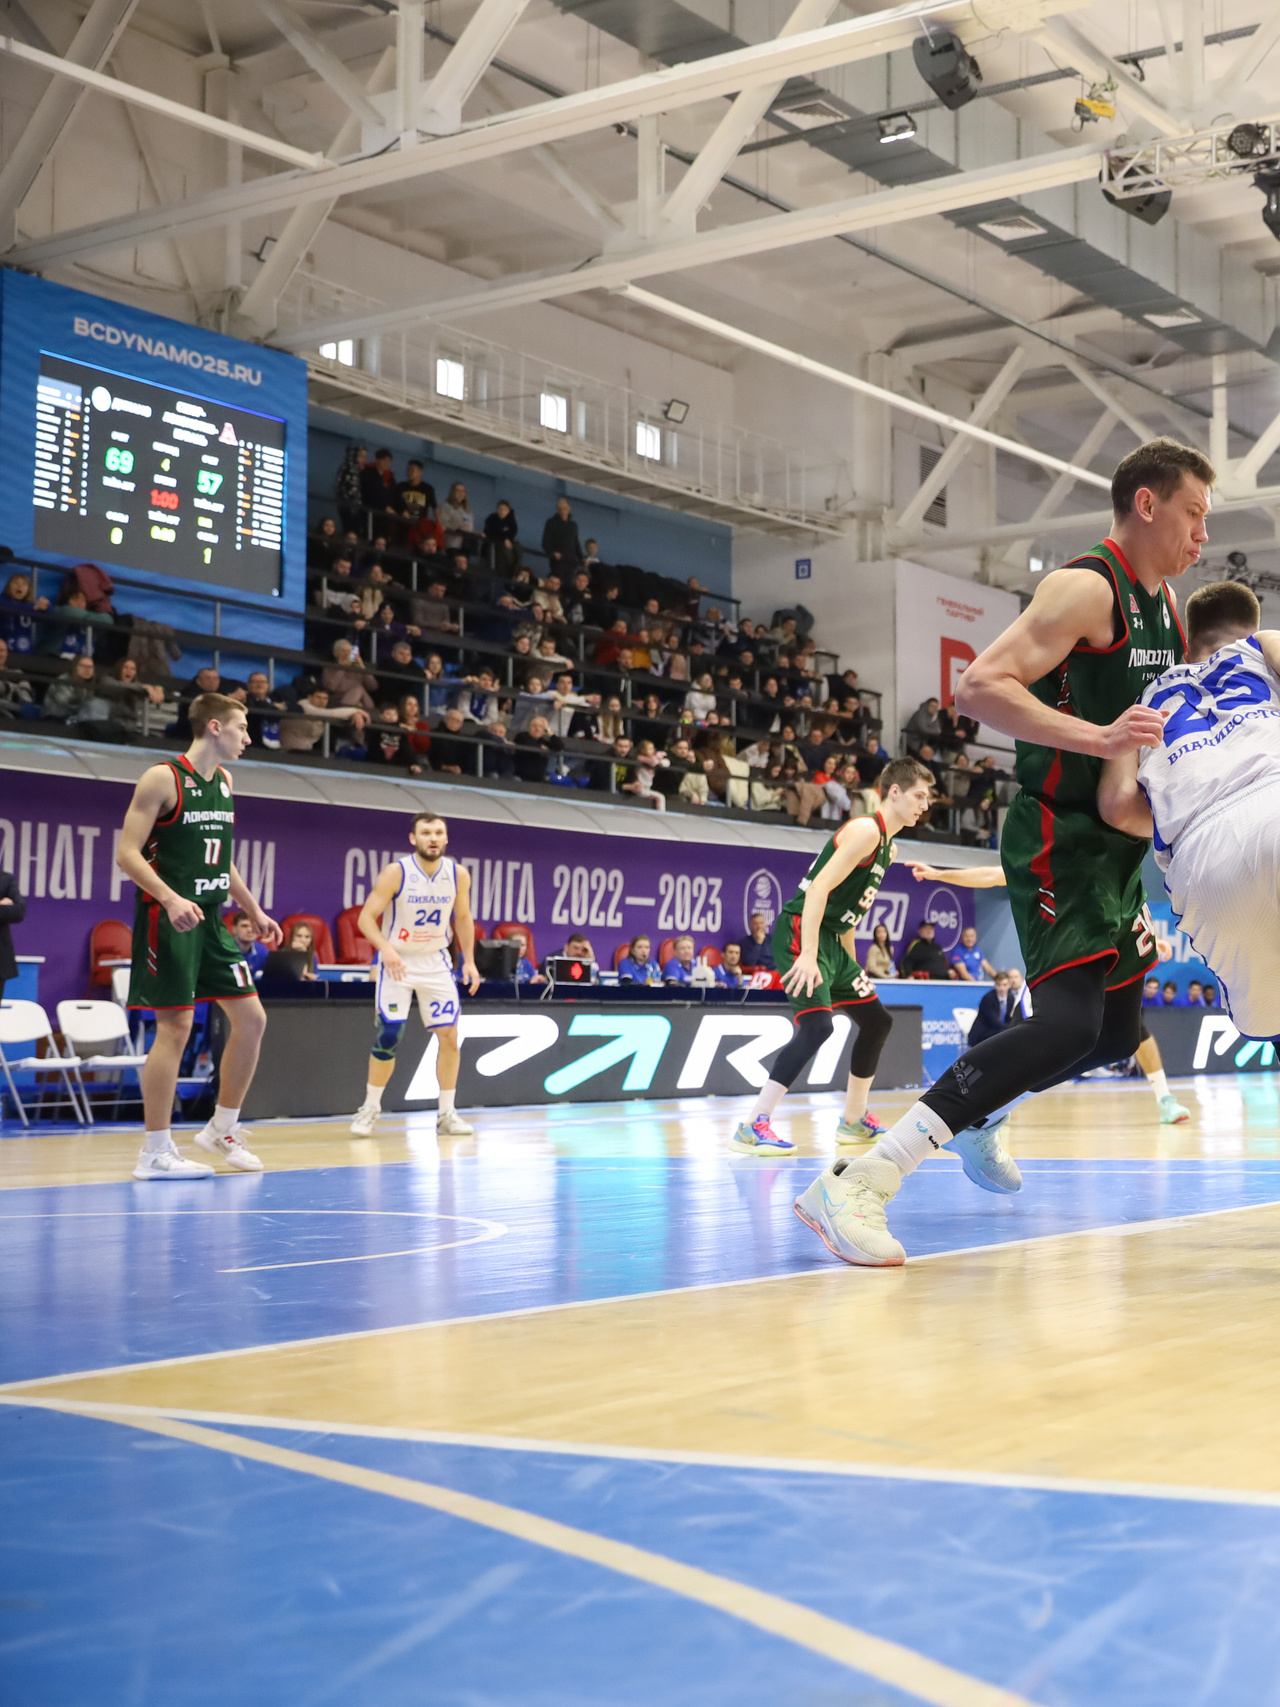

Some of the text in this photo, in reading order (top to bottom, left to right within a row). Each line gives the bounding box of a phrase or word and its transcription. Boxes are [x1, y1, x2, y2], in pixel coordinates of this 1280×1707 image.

[74, 317, 262, 386] BCDYNAMO25.RU
[105, 447, 134, 474] 69
[196, 470, 224, 495] 57
[1147, 653, 1271, 748] 25
[203, 838, 221, 865] 11
[407, 895, 451, 904] ДИНАМО
[414, 909, 441, 926] 24
[430, 1000, 455, 1018] 24
